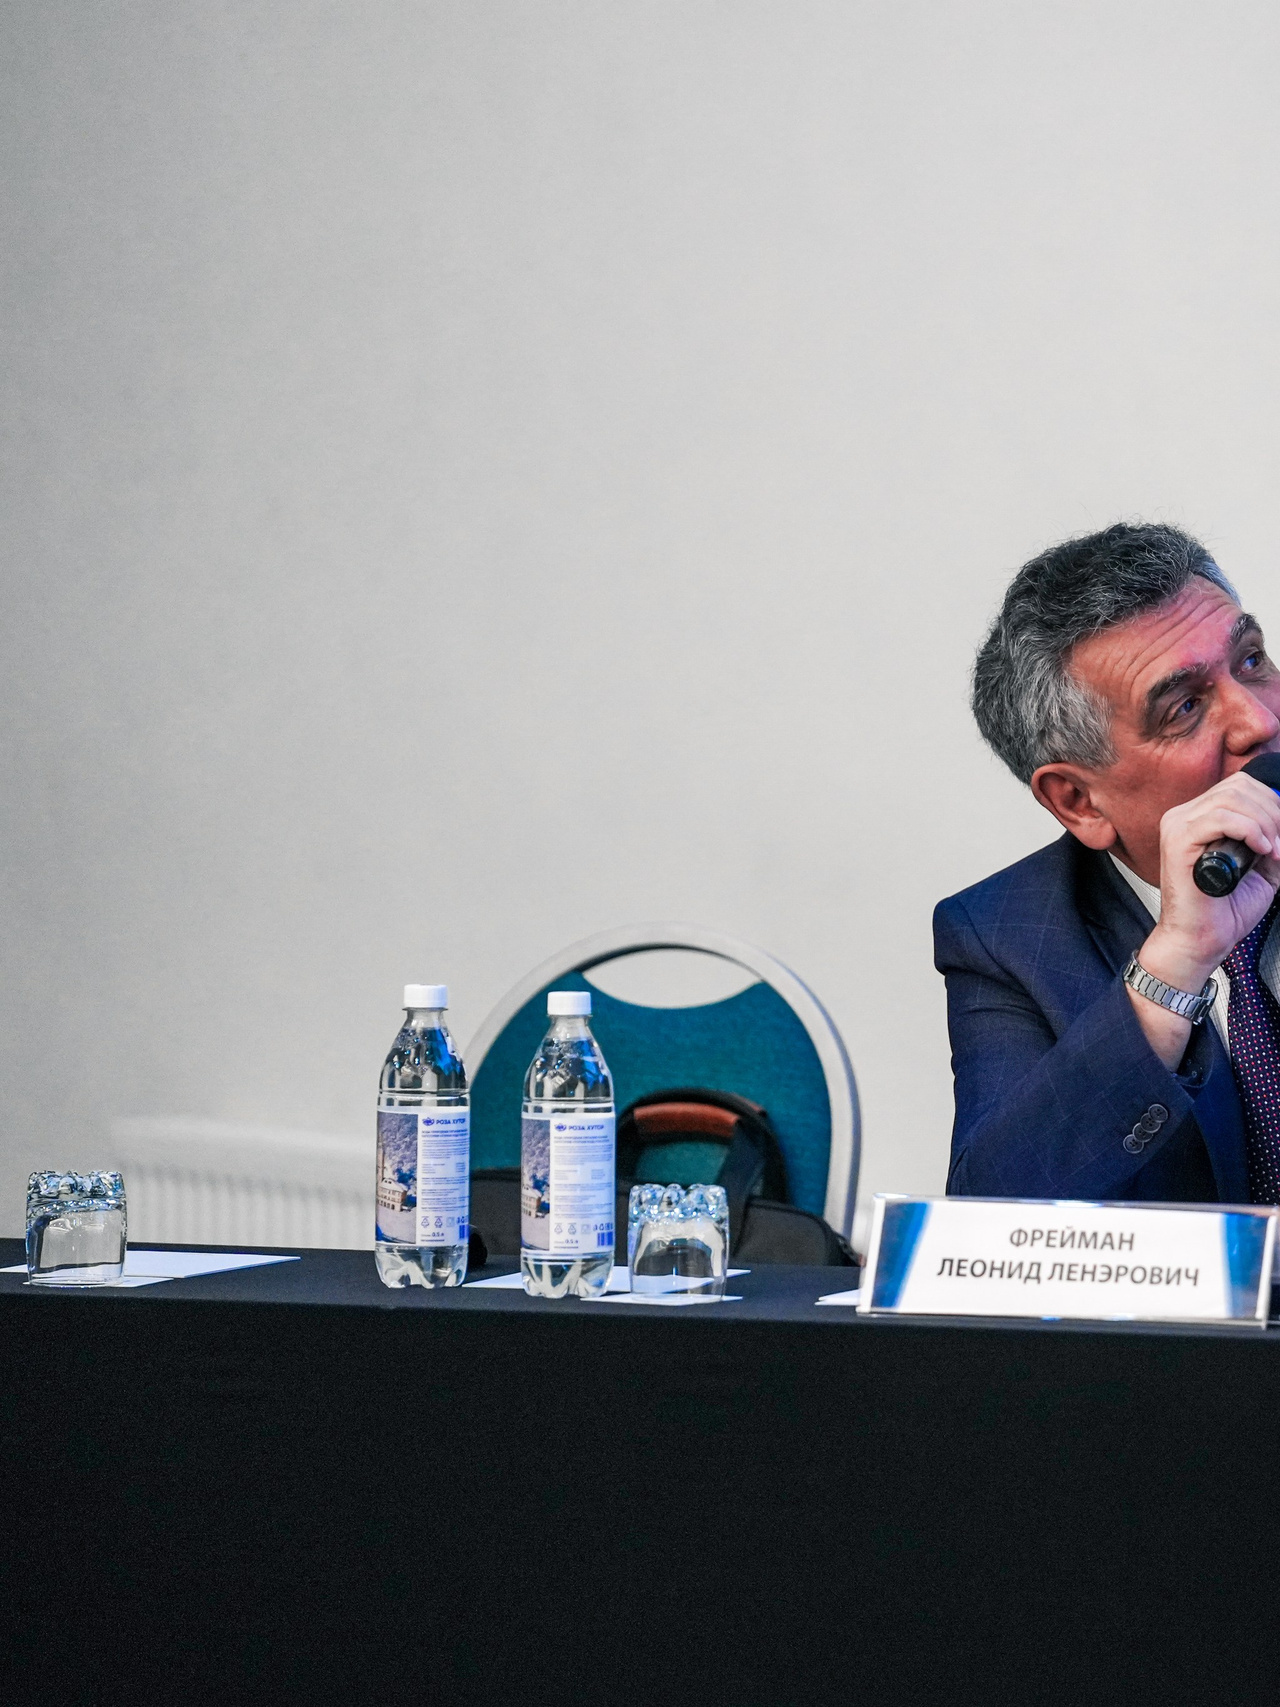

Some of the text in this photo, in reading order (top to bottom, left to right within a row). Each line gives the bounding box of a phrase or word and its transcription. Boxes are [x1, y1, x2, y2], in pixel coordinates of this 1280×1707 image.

[1009, 1226, 1135, 1251] ФРЕЙМАН
[937, 1258, 1200, 1287] ЛЕОНИД ЛЕНЭРОВИЧ
